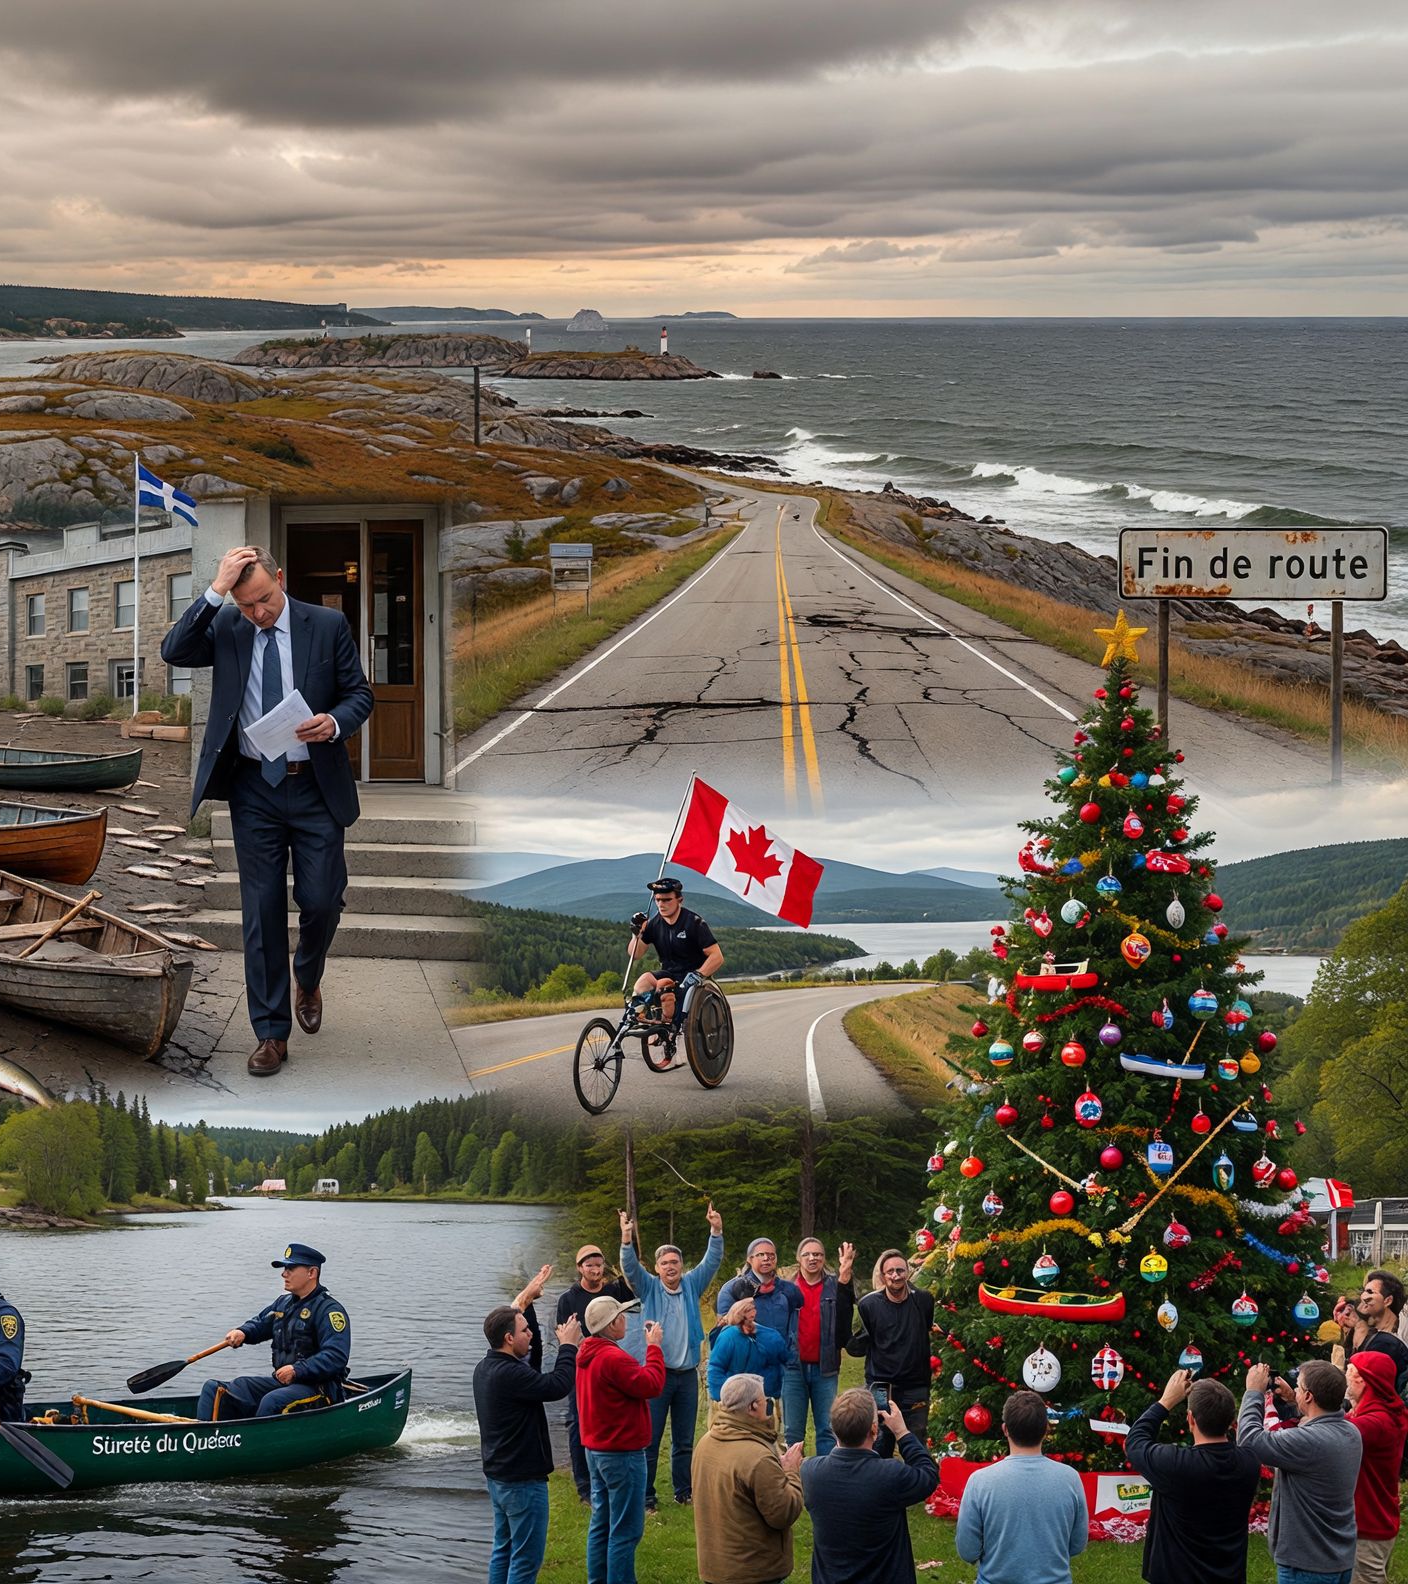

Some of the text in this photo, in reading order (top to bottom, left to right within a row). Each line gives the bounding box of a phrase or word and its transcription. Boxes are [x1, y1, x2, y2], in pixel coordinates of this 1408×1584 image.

[1138, 547, 1369, 580] Fin de route
[156, 1433, 178, 1453] du
